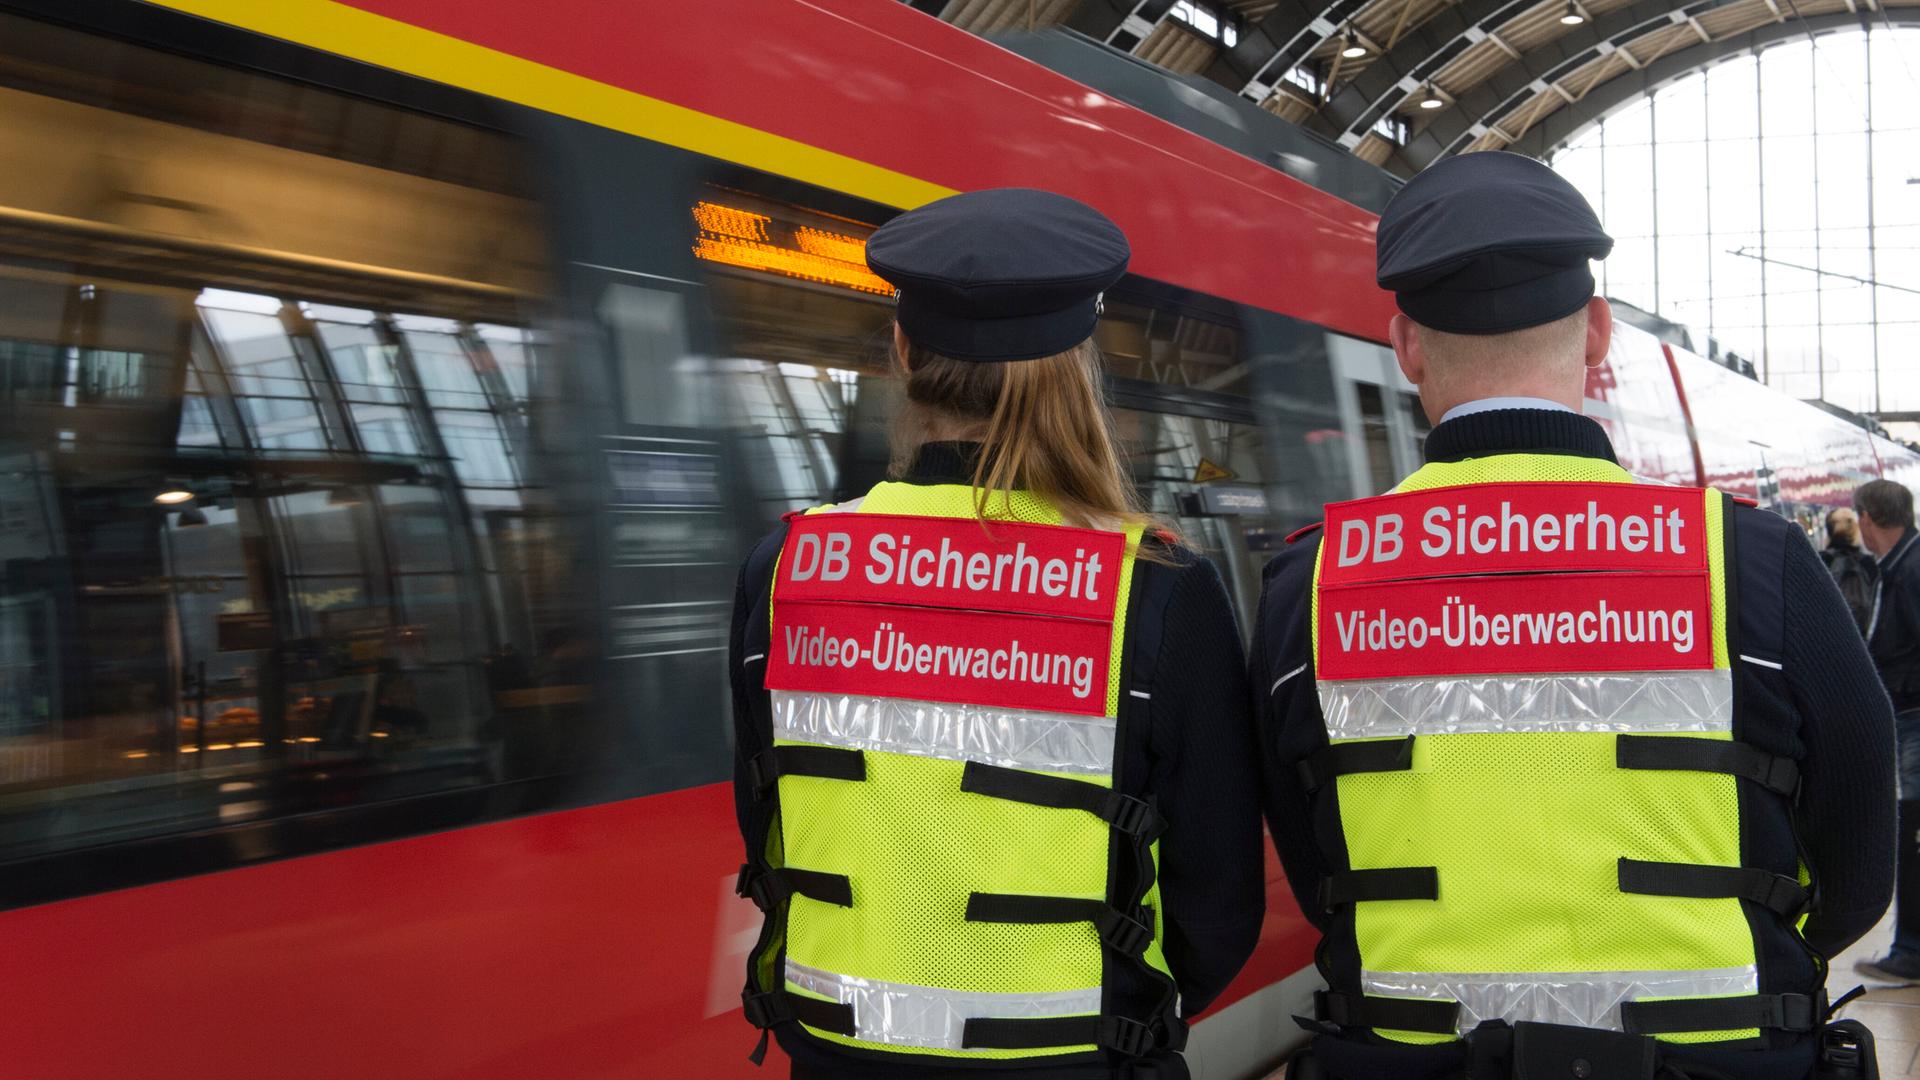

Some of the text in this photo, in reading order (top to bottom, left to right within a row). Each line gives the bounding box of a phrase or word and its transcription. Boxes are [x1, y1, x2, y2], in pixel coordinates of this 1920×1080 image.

[790, 532, 1102, 601] DB Sicherheit
[1337, 500, 1686, 568] DB Sicherheit
[1334, 595, 1694, 653] Video-Überwachung
[784, 622, 1094, 699] Video-Überwachung
